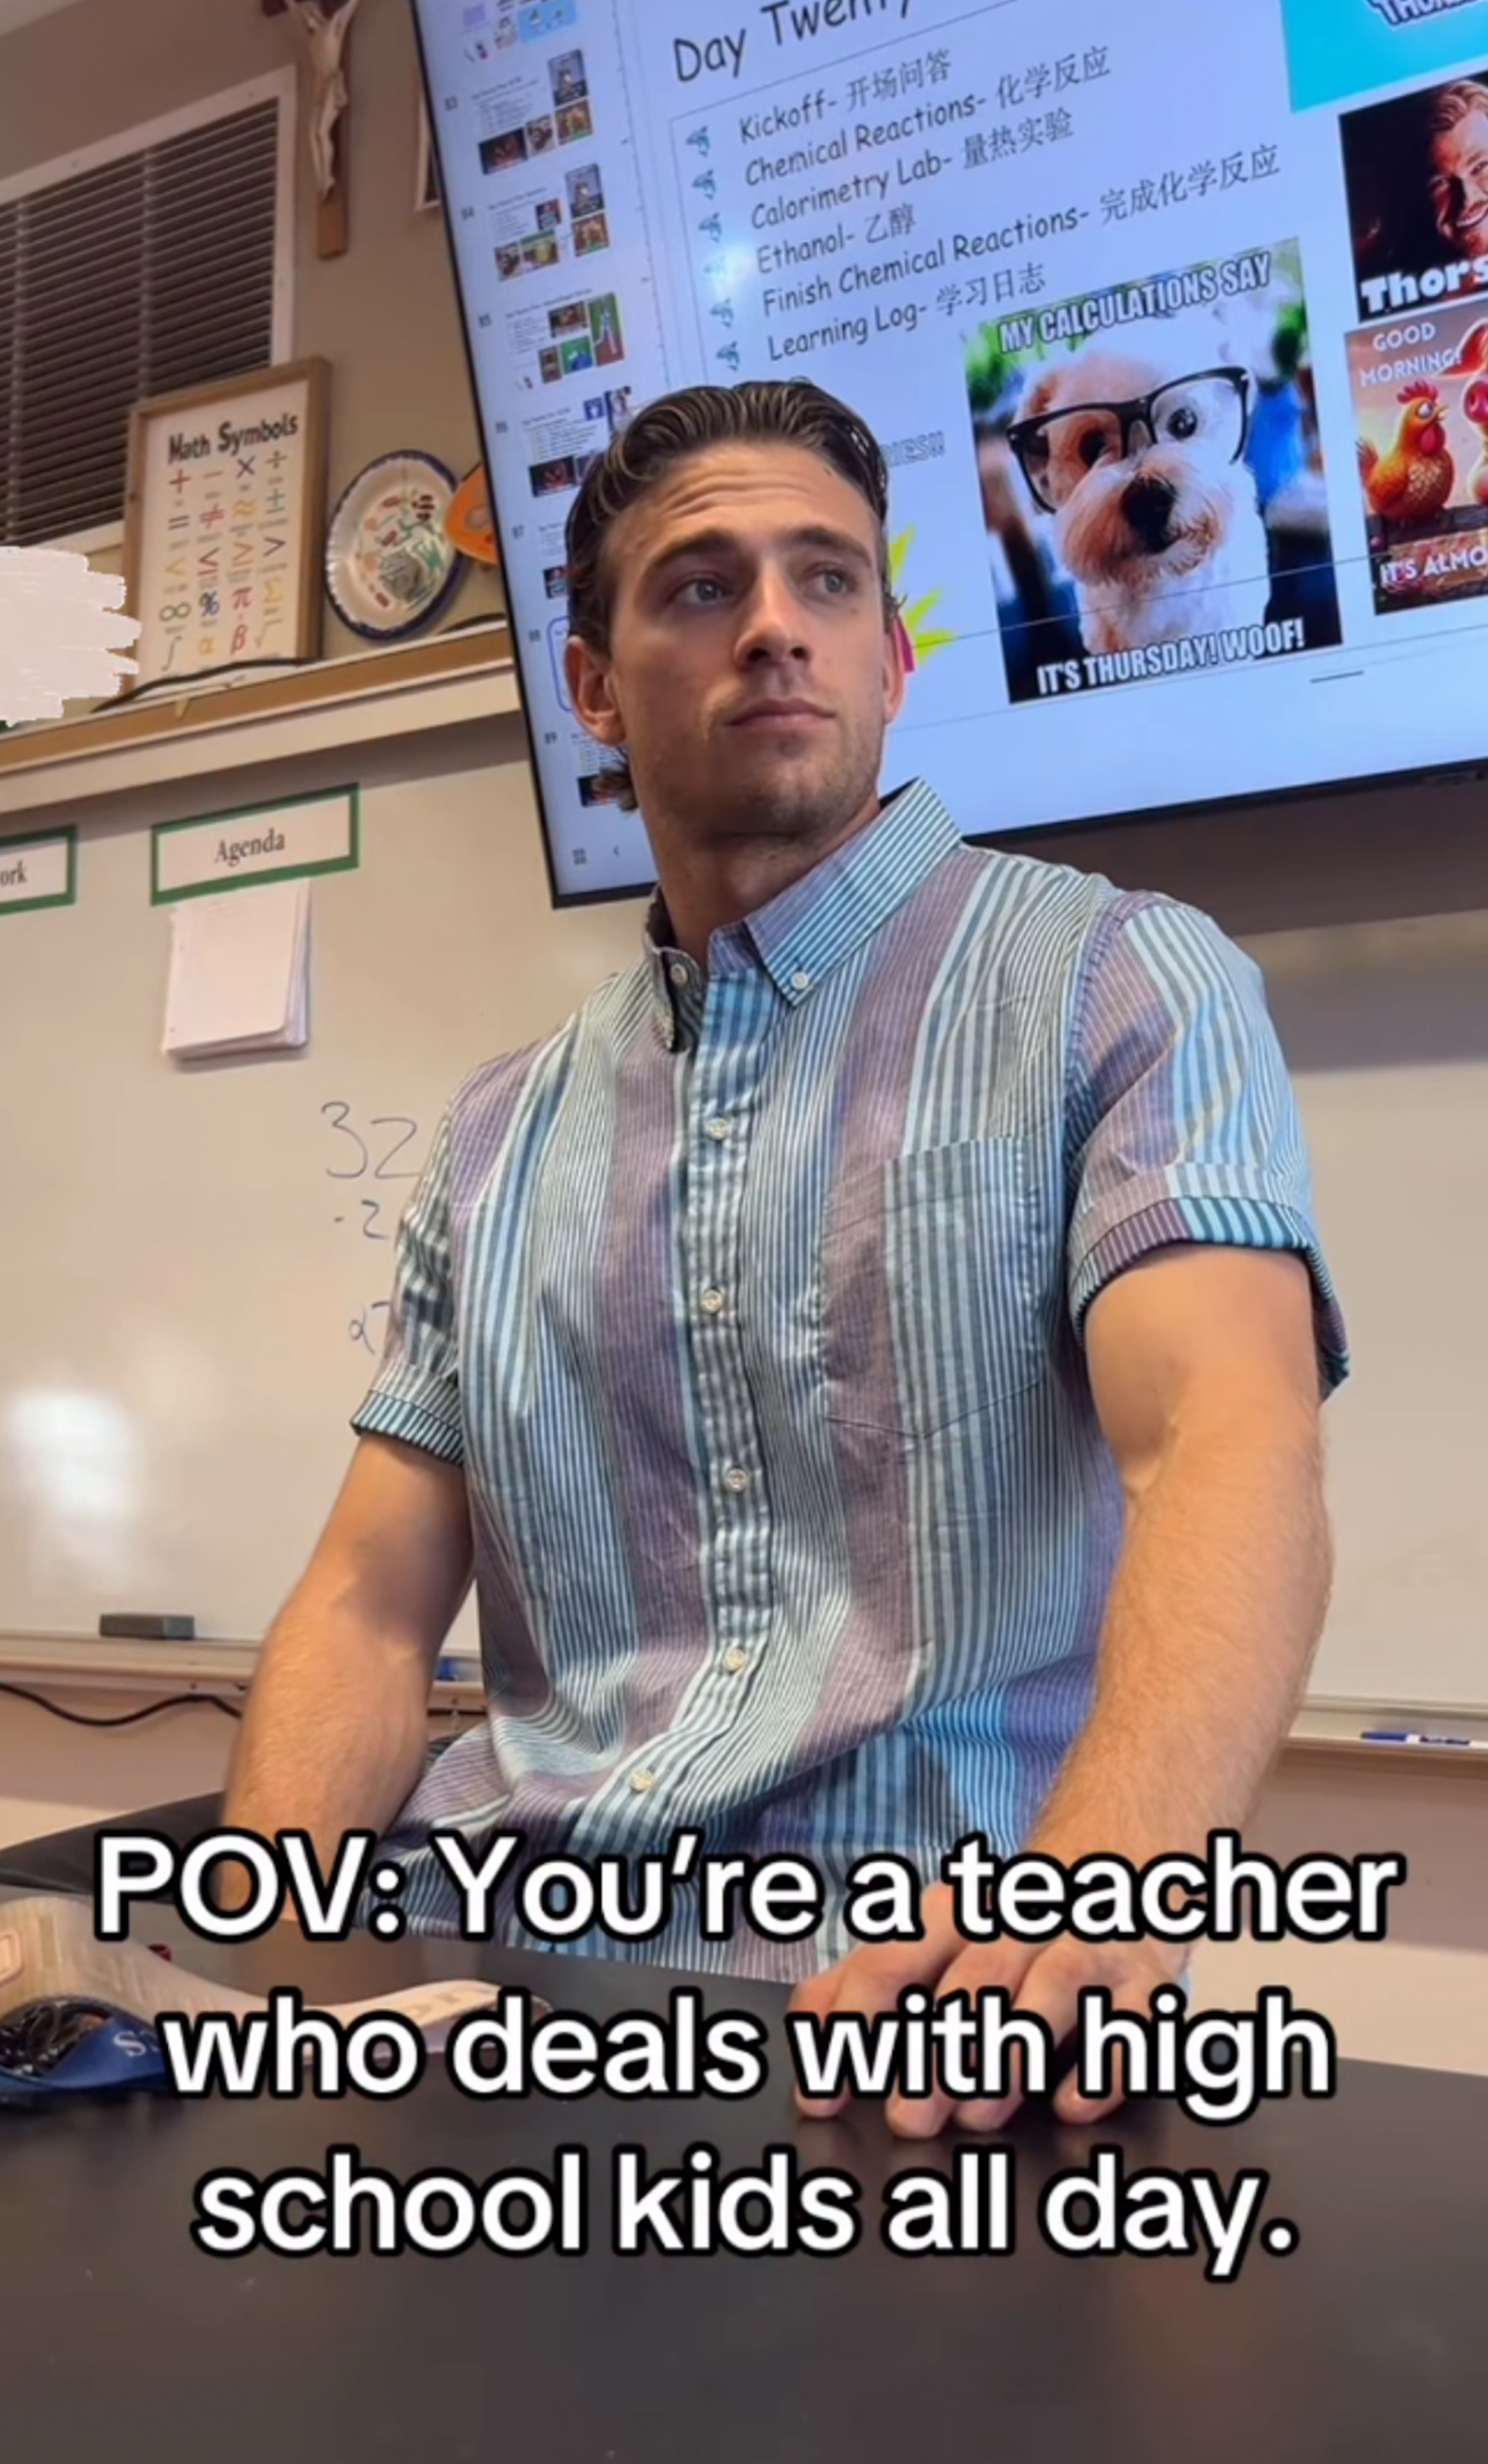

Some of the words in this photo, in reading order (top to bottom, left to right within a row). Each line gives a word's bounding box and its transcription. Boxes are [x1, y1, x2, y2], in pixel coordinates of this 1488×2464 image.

[673, 28, 745, 83] Day
[740, 89, 838, 144] Kickoff-
[846, 48, 952, 112] 开场问答
[746, 130, 847, 187] Chemical
[855, 92, 987, 150] Reactions-
[997, 45, 1112, 111] 化学反应
[751, 171, 889, 229] Calorimetry
[897, 150, 953, 186] Lab-
[963, 107, 1074, 170] 量热实验
[757, 224, 855, 274] Ethanol-
[865, 202, 917, 245] 乙醇
[763, 277, 832, 318] Finish
[838, 239, 946, 294] Chemical
[953, 209, 1090, 261] Reactions-
[1100, 144, 1282, 225] 完成化学反应
[768, 315, 869, 362] Learning
[875, 301, 928, 335] Log-
[936, 262, 1047, 317] 学习日志
[998, 314, 1039, 354] MY
[1039, 265, 1219, 344] CALCULATIONS
[1221, 251, 1273, 300] SAY
[1373, 322, 1436, 352] GOOD
[1359, 347, 1463, 387] MORNING!
[168, 432, 211, 464] Math
[218, 413, 299, 455] Symbols
[1037, 660, 1082, 696] IT'S
[1083, 635, 1219, 688] THURSDAY!
[1219, 617, 1306, 663] WOOF!
[214, 828, 286, 868] Agenda
[320, 1101, 423, 1179] 32
